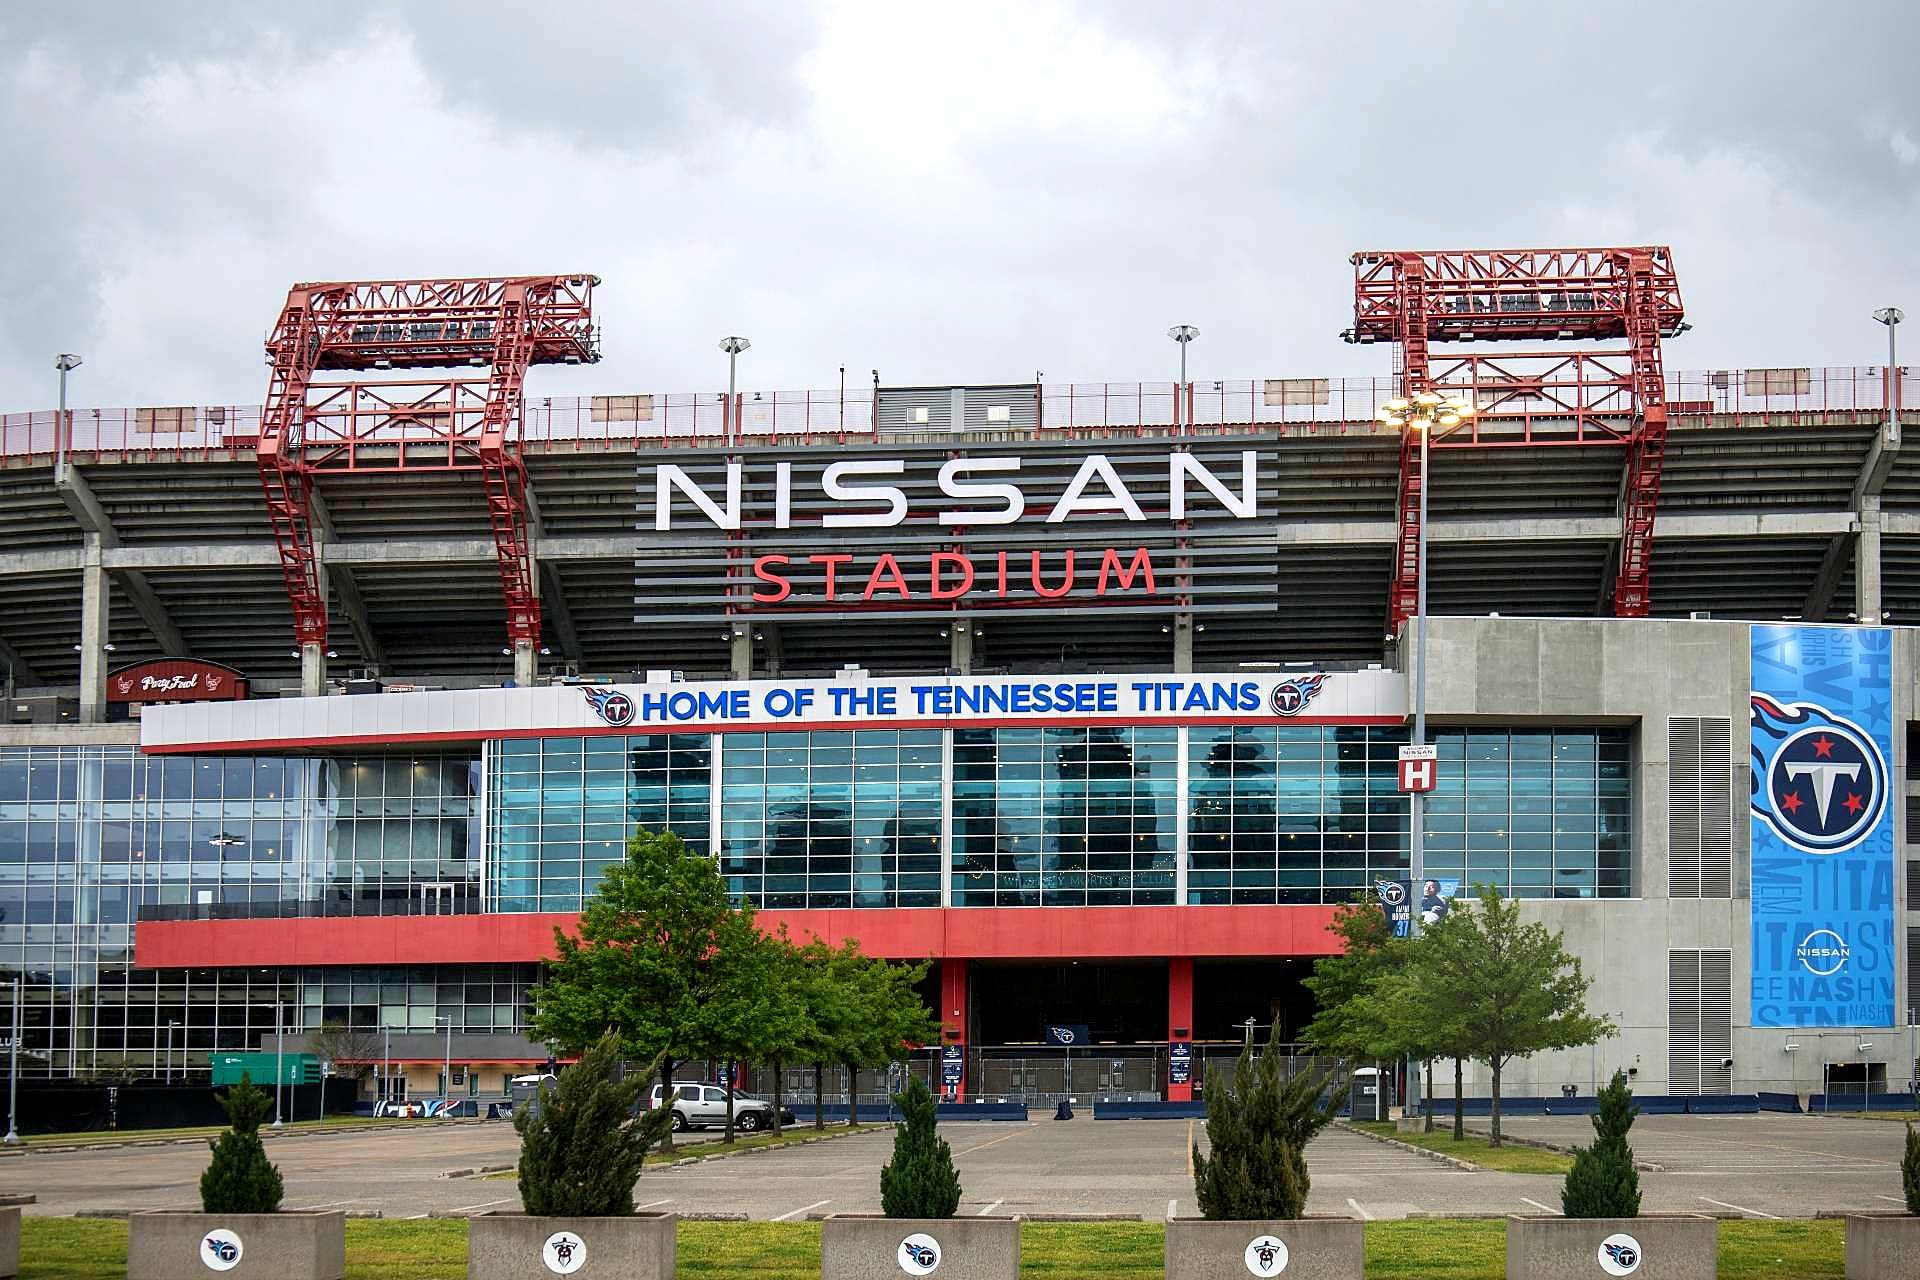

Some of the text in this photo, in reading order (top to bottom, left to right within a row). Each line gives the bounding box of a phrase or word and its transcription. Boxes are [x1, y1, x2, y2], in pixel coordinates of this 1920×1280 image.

[656, 451, 1257, 531] NISSAN
[752, 547, 1157, 602] STADIUM
[170, 673, 198, 689] Fowl
[643, 681, 1261, 721] HOME OF THE TENNESSEE TITANS
[1405, 761, 1430, 788] H
[1396, 921, 1408, 936] 37
[1797, 948, 1850, 957] NISSAN
